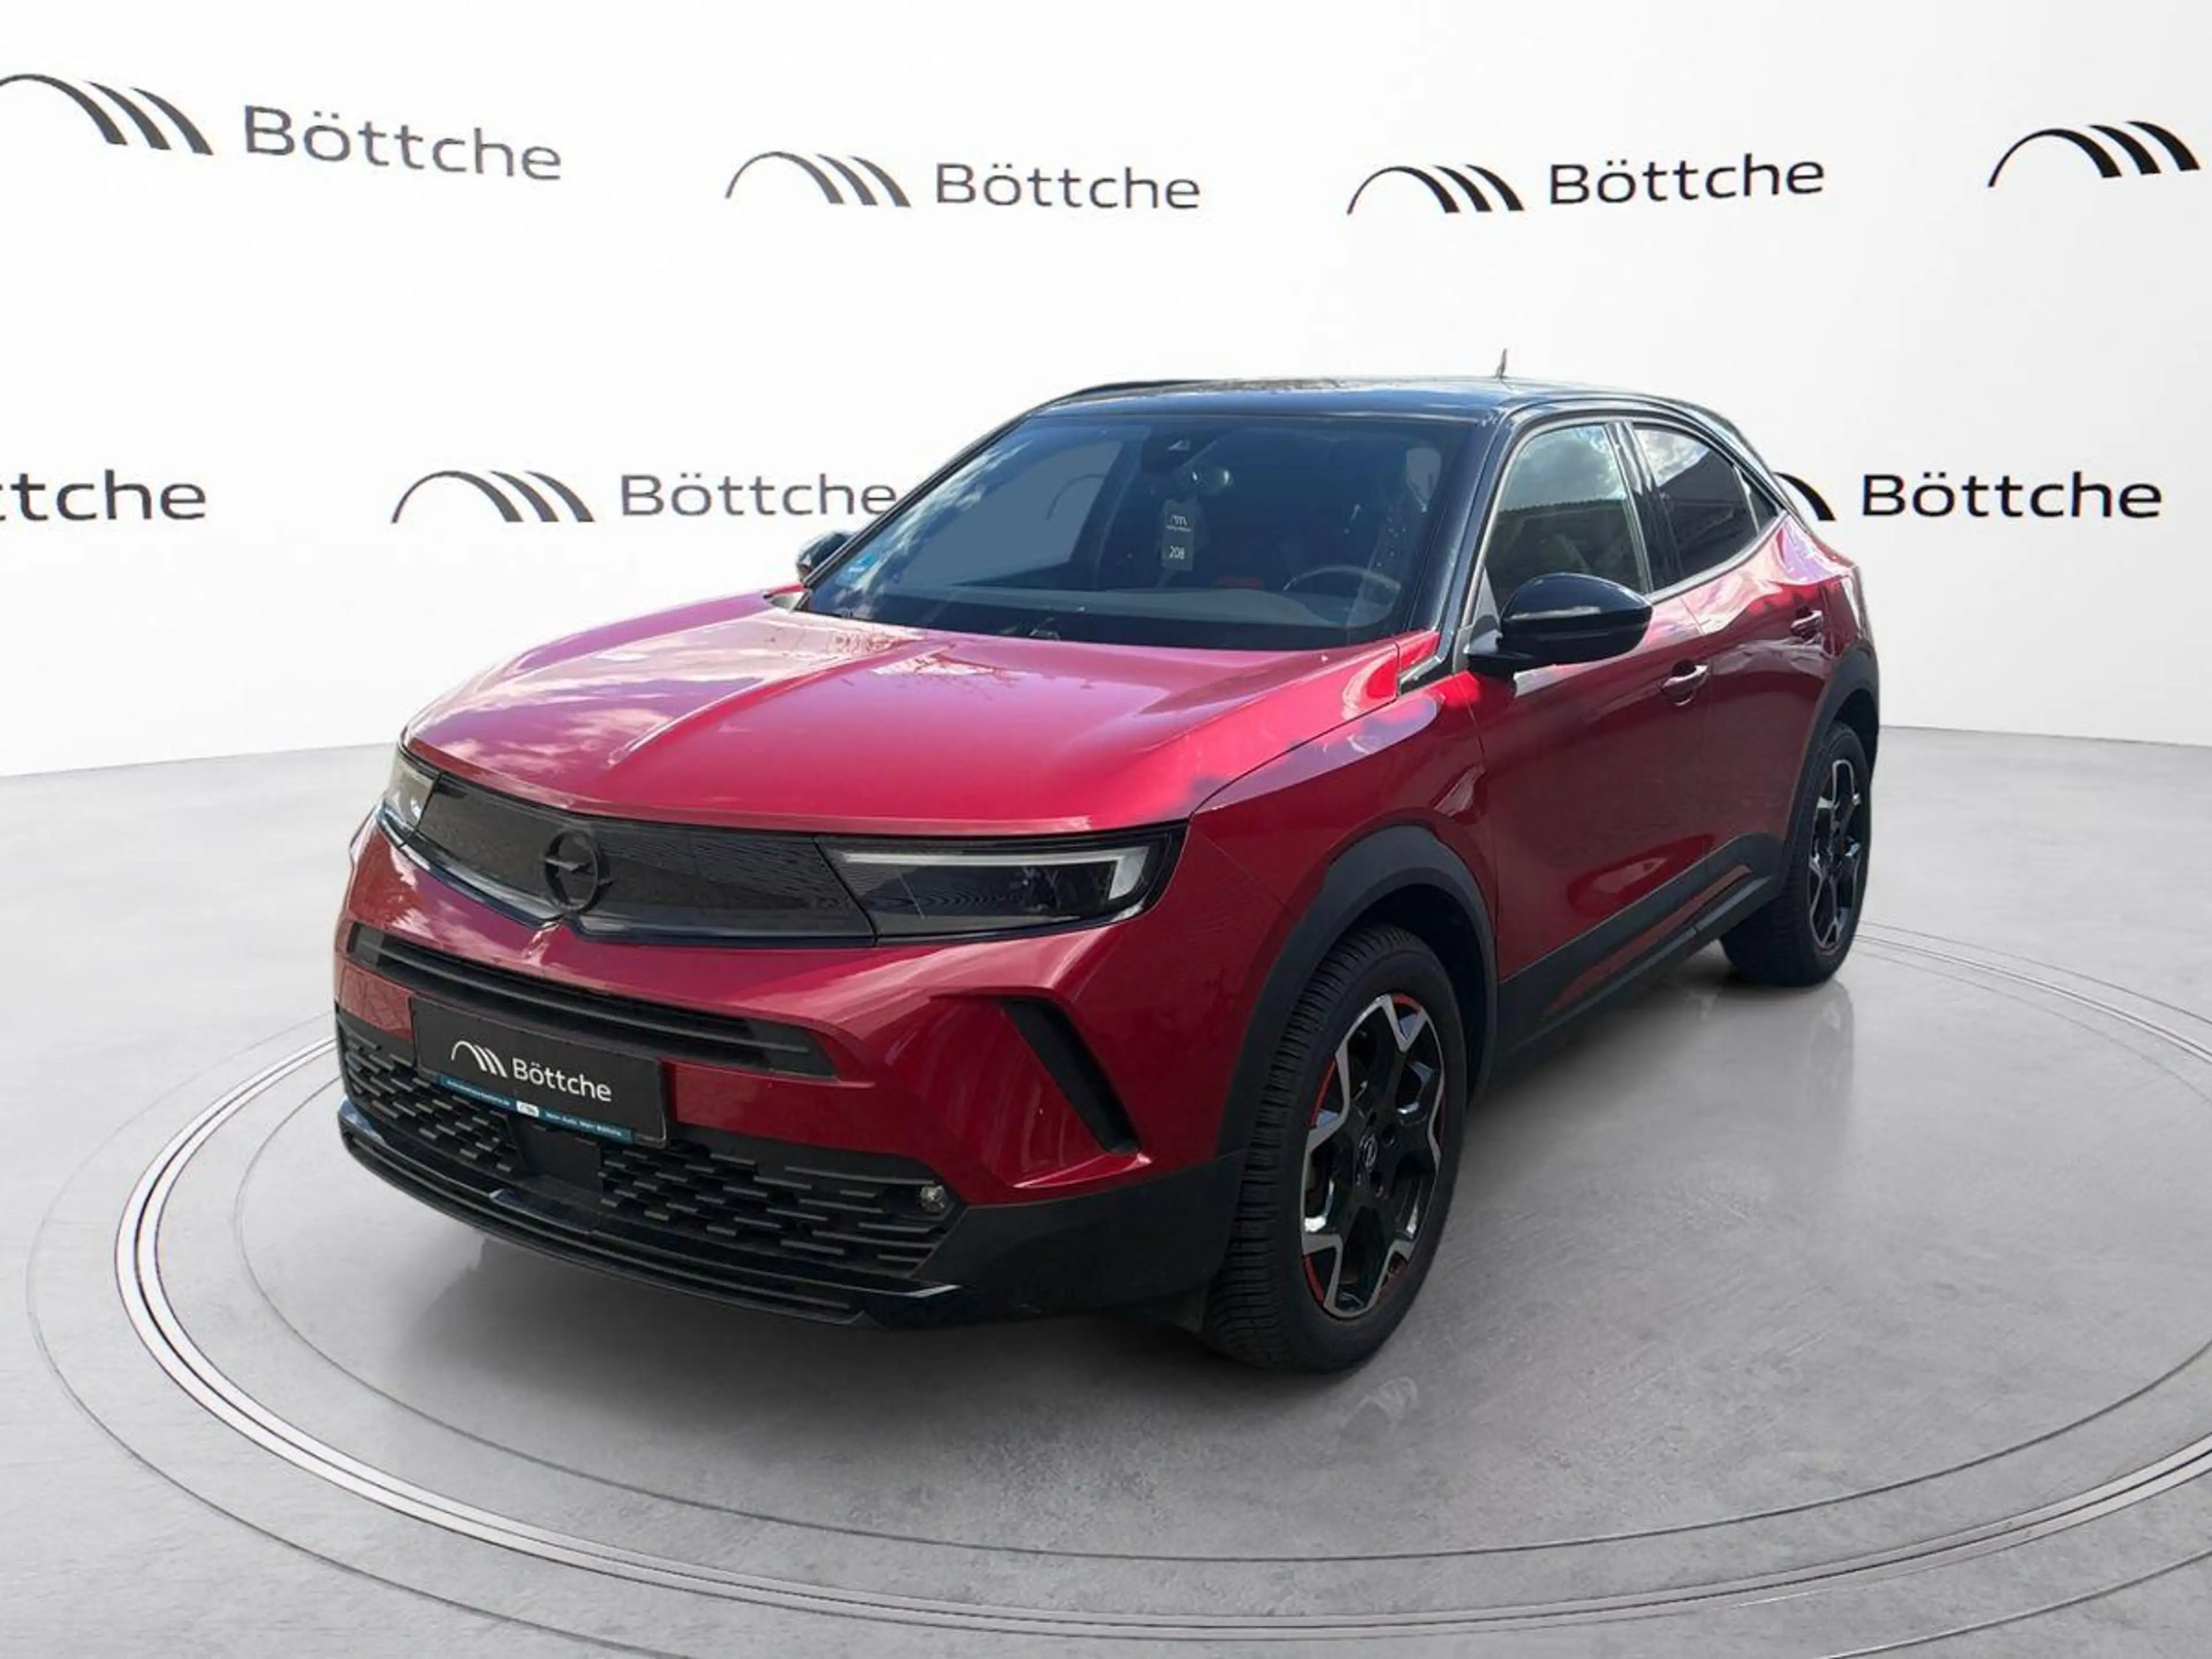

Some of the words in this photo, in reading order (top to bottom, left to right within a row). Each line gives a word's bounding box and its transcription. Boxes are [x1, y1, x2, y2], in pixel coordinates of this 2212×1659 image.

[245, 105, 560, 180] Böttche
[937, 164, 1200, 210] Böttche
[1551, 153, 1824, 204] Böttche
[0, 469, 206, 522] tche
[622, 473, 897, 516] Böttche
[1862, 471, 2162, 518] Böttche
[512, 1058, 612, 1102] Böttche
